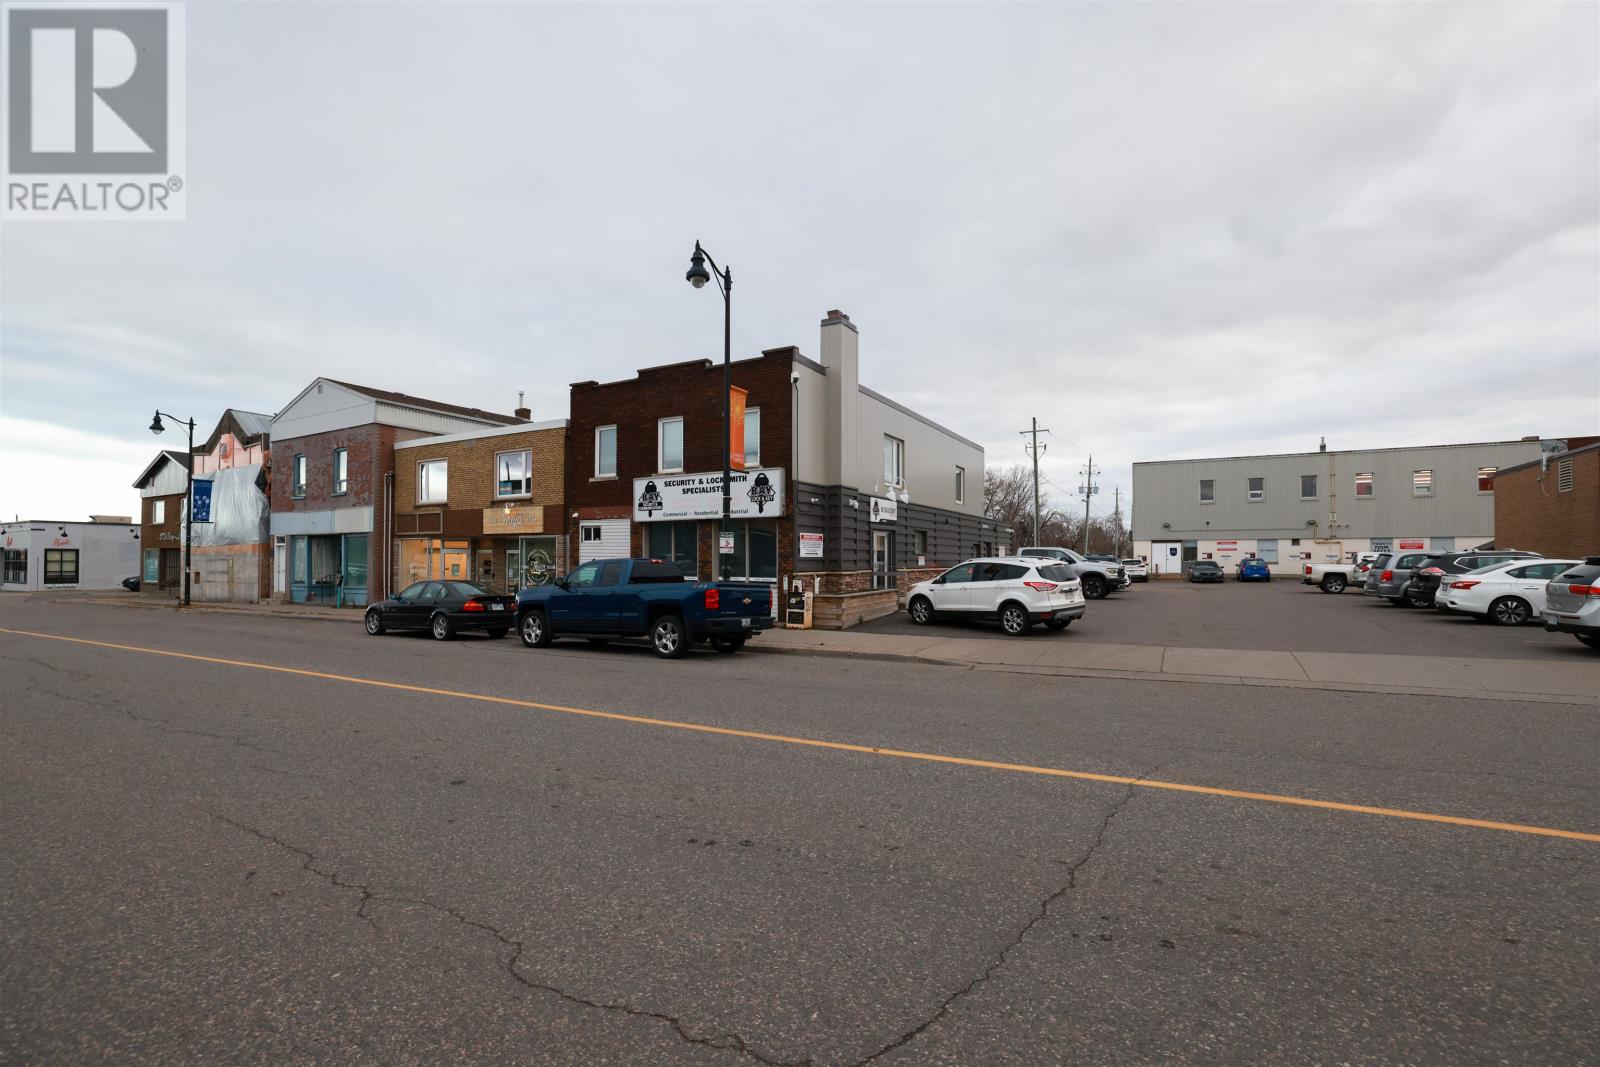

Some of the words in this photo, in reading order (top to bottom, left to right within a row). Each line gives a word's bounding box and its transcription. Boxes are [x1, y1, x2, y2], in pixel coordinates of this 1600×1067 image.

[664, 479, 696, 487] SECURITY
[706, 475, 747, 485] LOCKMITH
[751, 486, 772, 495] BAY
[642, 492, 659, 502] BAY
[694, 509, 719, 517] Residential
